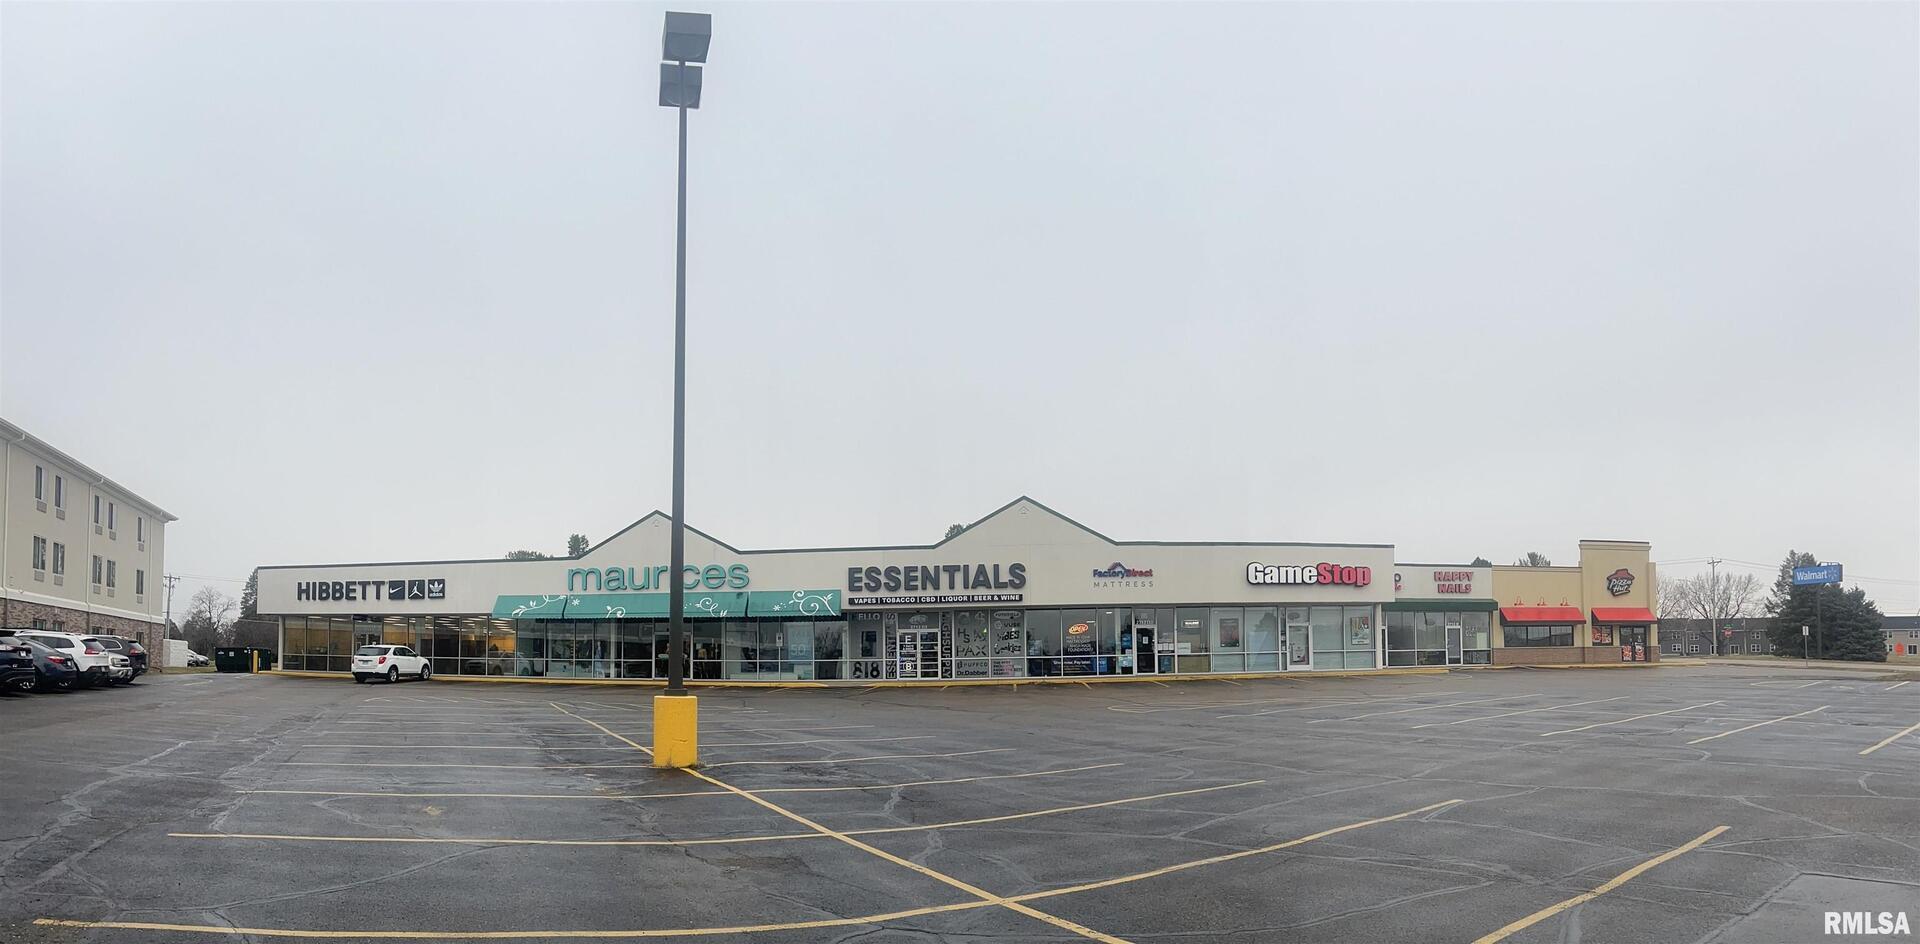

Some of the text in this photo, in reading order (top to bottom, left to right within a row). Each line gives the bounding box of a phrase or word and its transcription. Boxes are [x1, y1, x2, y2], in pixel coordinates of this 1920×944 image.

[567, 564, 751, 592] maurces
[847, 563, 1027, 592] ESSENTIALS
[1246, 561, 1372, 587] GameStop
[1433, 571, 1474, 582] HAPPY
[1796, 569, 1828, 581] Walmart
[297, 580, 386, 601] HIBBETT
[1437, 583, 1472, 594] NAILS
